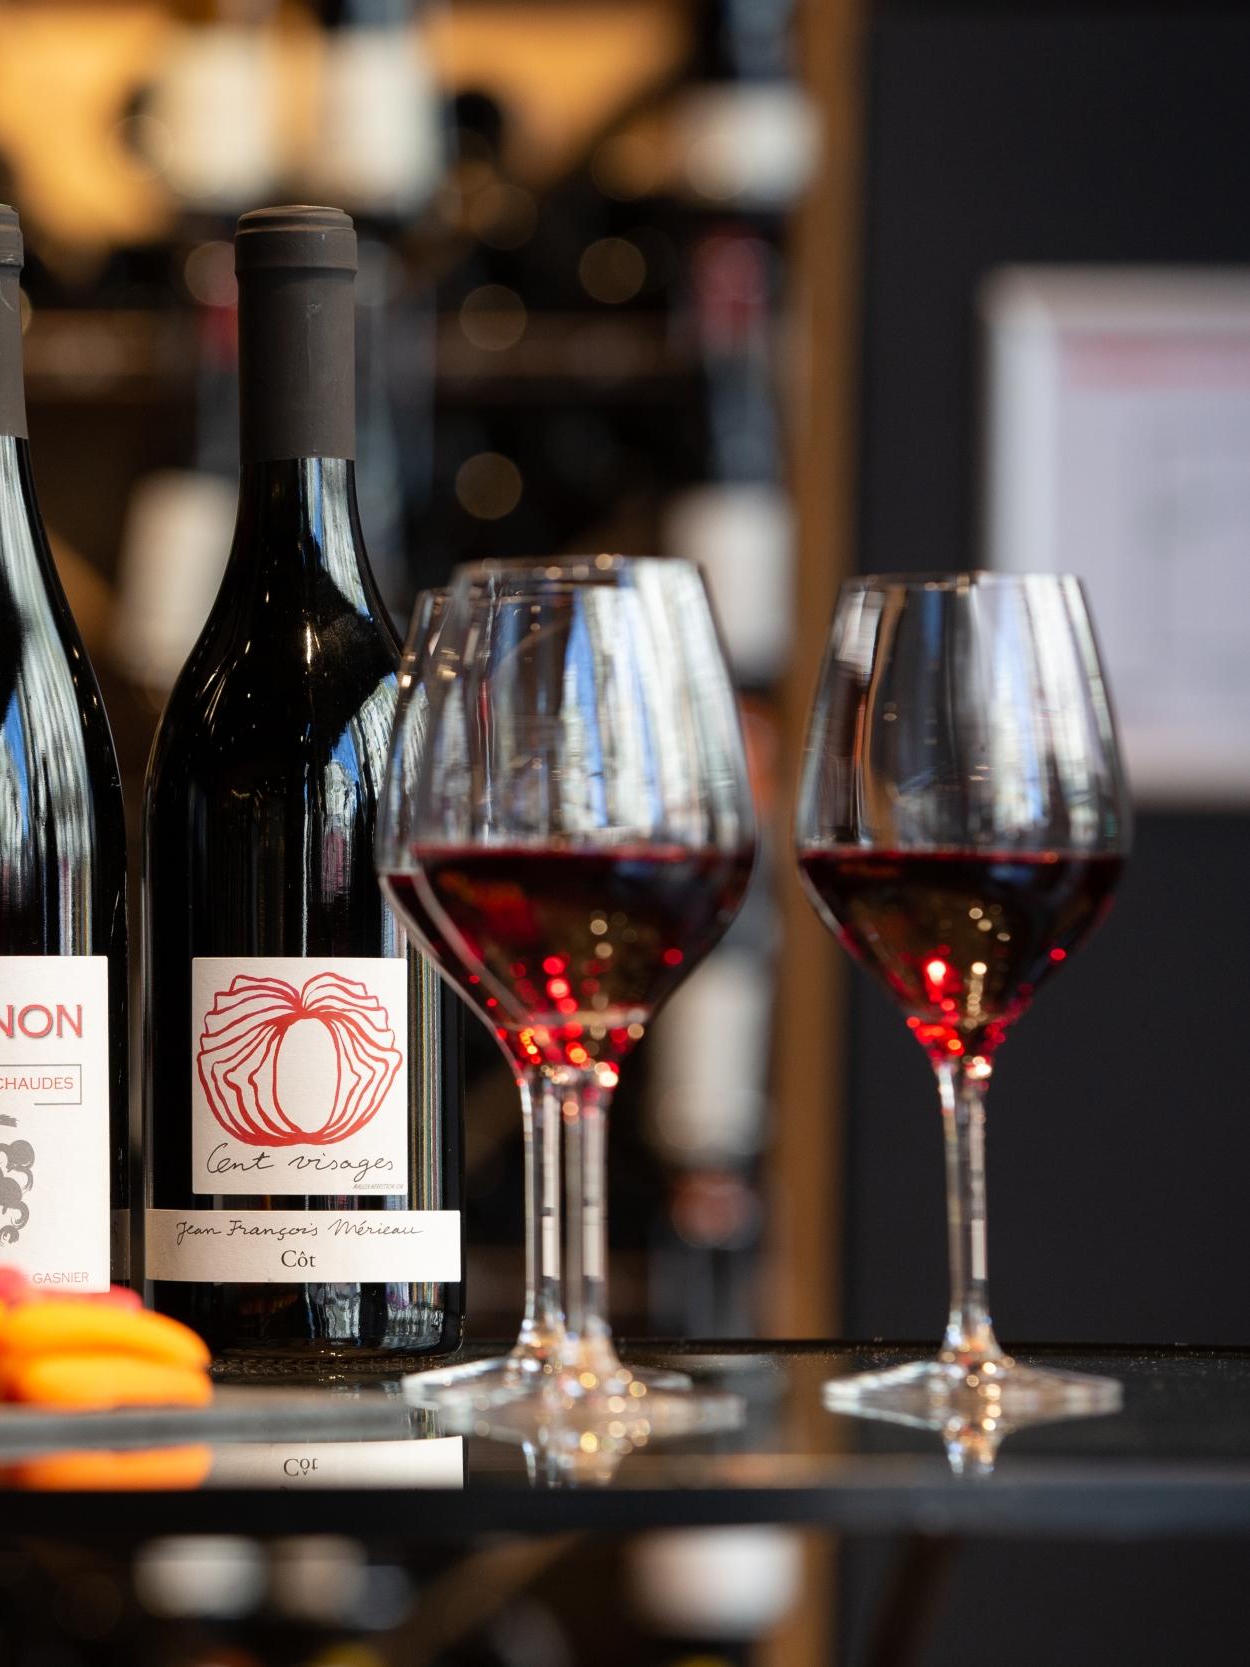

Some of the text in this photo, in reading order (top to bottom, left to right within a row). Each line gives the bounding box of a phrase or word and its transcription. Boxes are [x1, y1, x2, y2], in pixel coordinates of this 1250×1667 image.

[206, 1142, 393, 1182] Cent visages
[176, 1218, 424, 1245] Jean François Mérieau
[281, 1249, 316, 1268] Côt
[32, 1272, 90, 1284] GASNIER
